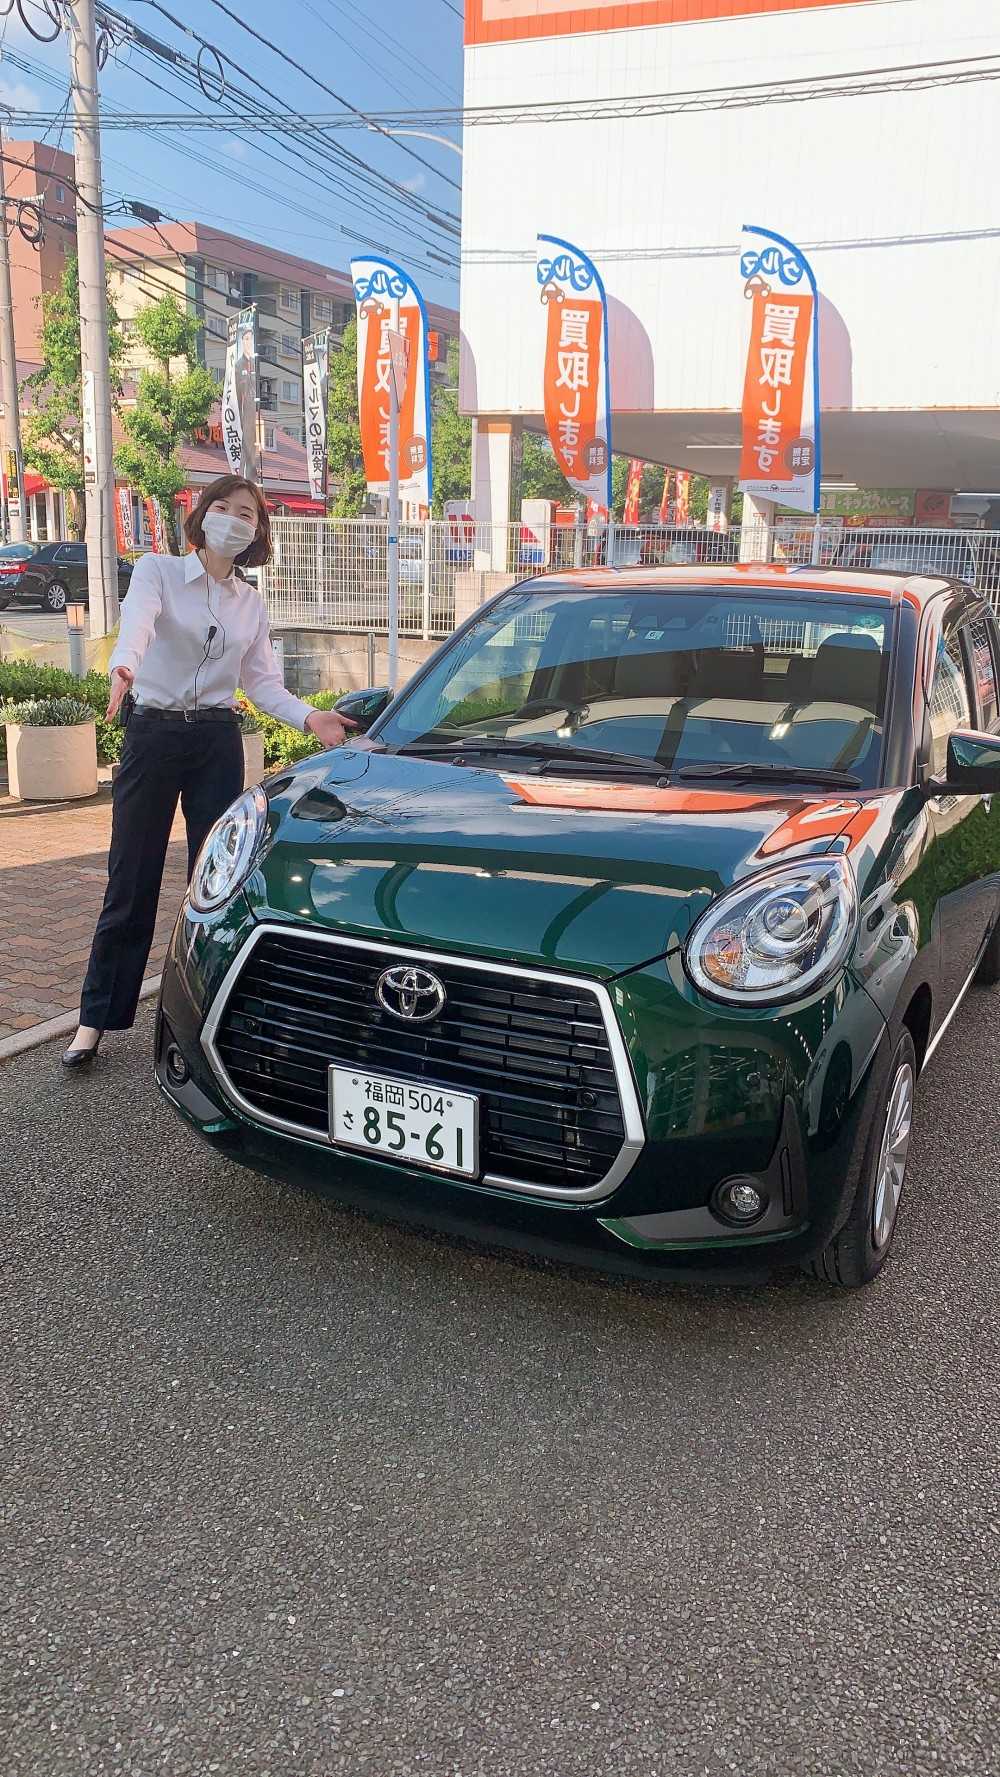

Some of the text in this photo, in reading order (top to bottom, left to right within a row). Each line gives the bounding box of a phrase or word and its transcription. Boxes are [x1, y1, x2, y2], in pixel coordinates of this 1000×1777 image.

[364, 1079, 446, 1117] 福岡 504
[342, 1106, 463, 1168] さ 85-61
